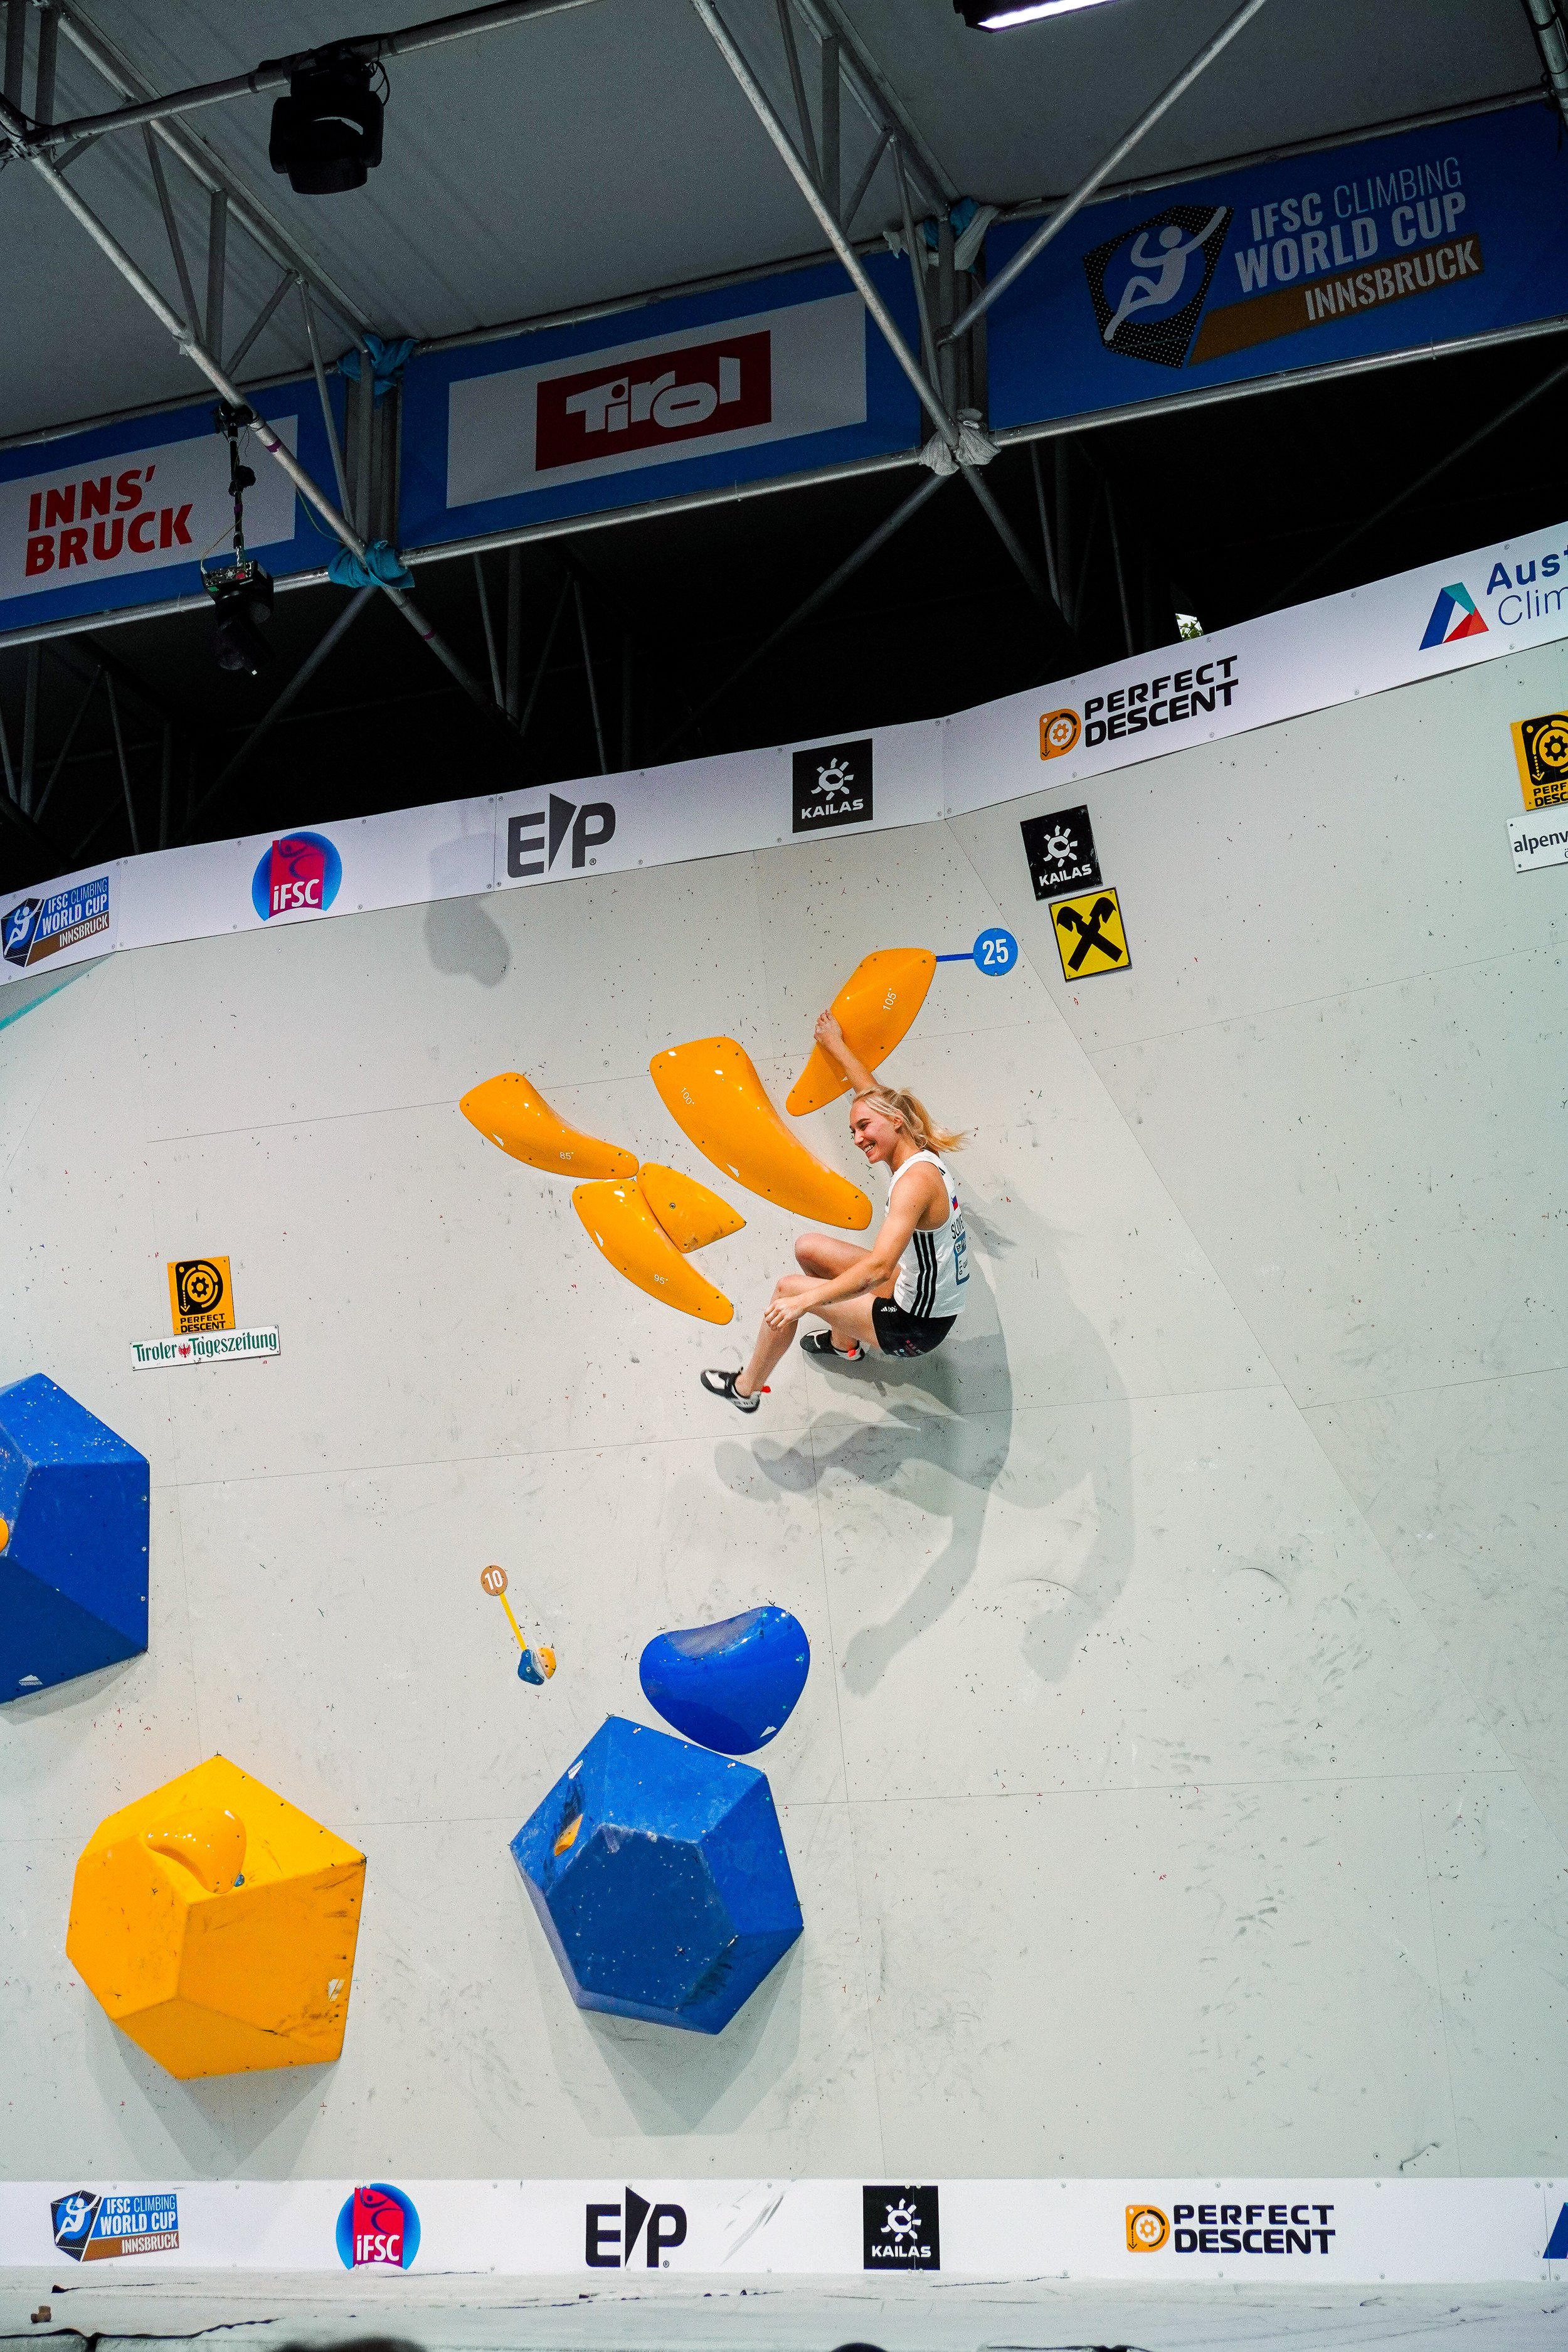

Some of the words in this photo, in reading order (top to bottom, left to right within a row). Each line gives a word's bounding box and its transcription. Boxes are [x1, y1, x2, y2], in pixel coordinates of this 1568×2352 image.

[1251, 191, 1323, 241] IFSC
[1333, 156, 1461, 218] CLIMBING
[1234, 216, 1379, 293] WORLD
[1391, 191, 1466, 246] CUP
[1305, 240, 1479, 320] INNSBRUCK
[566, 356, 741, 433] Tirol
[25, 504, 193, 576] BRUCK
[1084, 655, 1237, 721] PERFECT
[1084, 679, 1239, 748] DESCENT
[801, 799, 864, 820] KAILAS
[1039, 864, 1092, 886] KAILAS
[48, 894, 68, 914] IFSC
[71, 879, 107, 904] CLIMBING
[42, 904, 82, 936] WORLD
[85, 894, 107, 916] CUP
[60, 914, 109, 948] INNSBRUCK
[982, 939, 1009, 965] 25
[180, 1313, 225, 1324] PERFECT
[181, 1321, 226, 1333] DESCENT
[188, 1331, 277, 1359] Tageszeitung
[484, 1569, 503, 1590] 10
[107, 2198, 130, 2214] IFSC
[134, 2195, 176, 2213] CLIMBING
[1173, 2205, 1334, 2225] PERFECT
[100, 2213, 147, 2235] WORLD
[151, 2211, 176, 2230] CUP
[122, 2233, 178, 2254] INNSBRUCK
[872, 2245, 931, 2258] KAILAS
[1174, 2229, 1336, 2254] DESCENT
